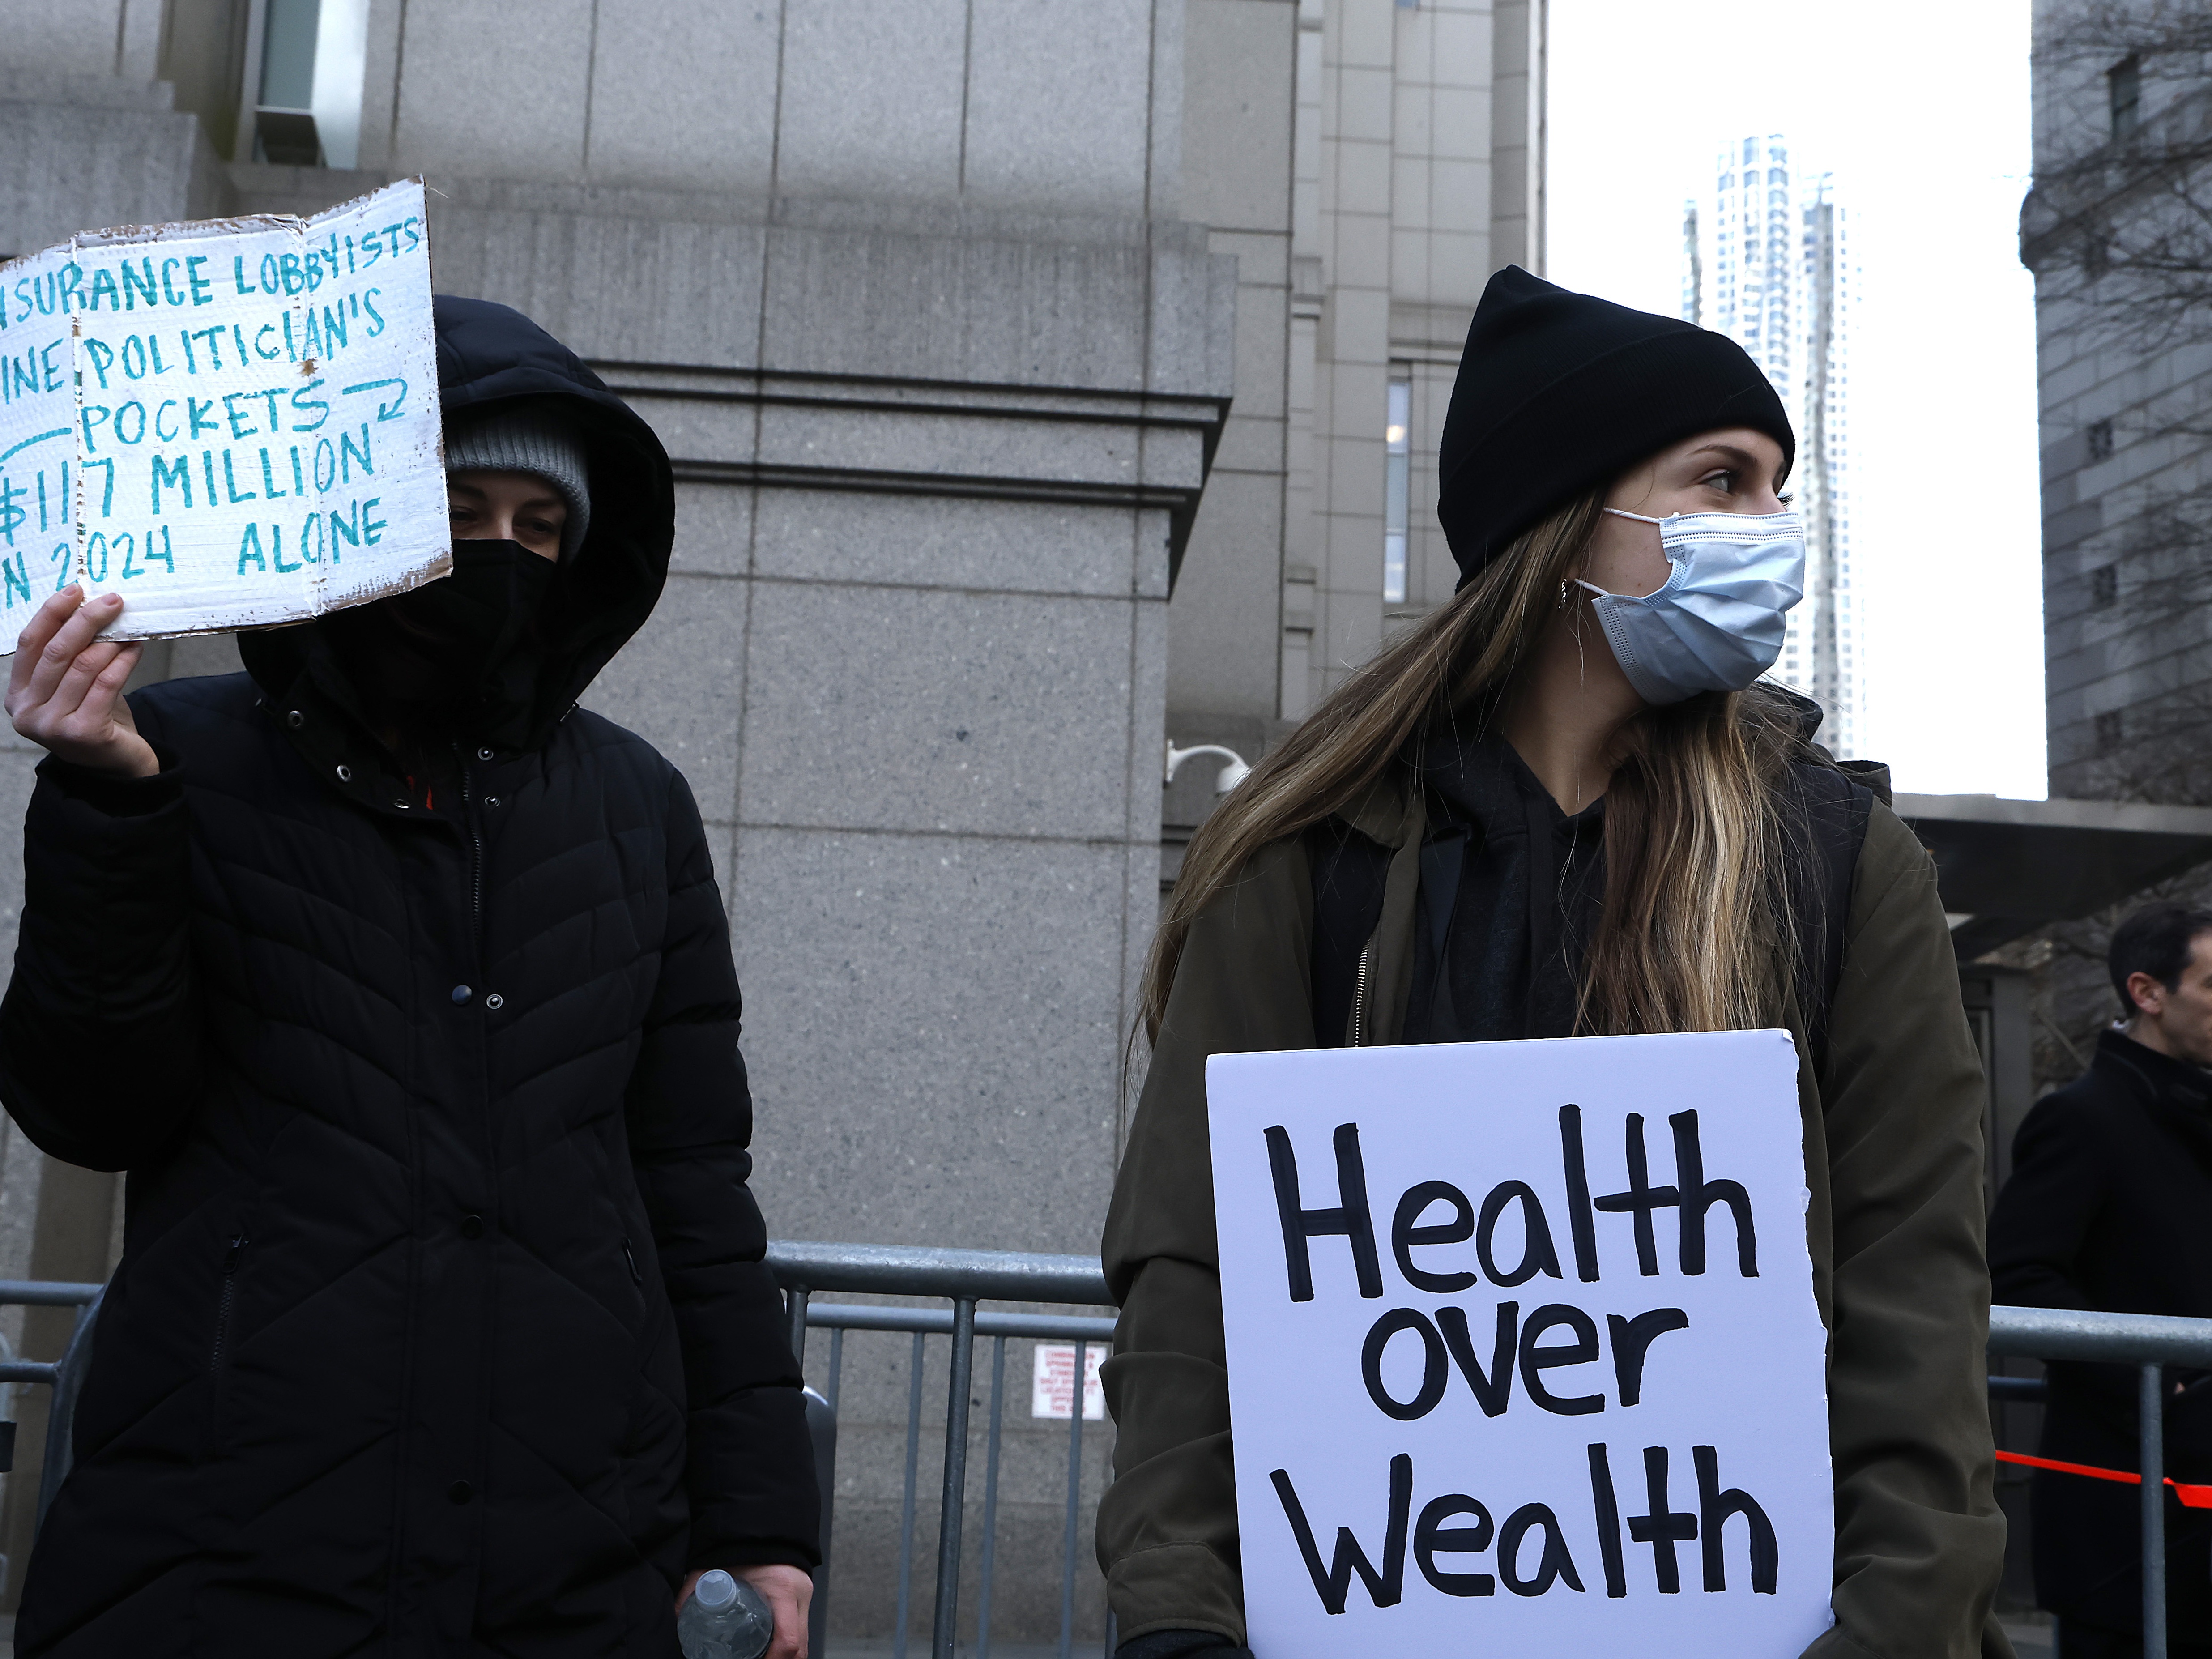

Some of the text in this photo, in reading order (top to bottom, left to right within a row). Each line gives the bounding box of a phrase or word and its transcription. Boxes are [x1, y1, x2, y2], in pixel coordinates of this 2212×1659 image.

[234, 215, 421, 297] LOBBYISTS
[82, 287, 385, 390] POLITICIAN'S
[81, 378, 330, 455] POCKETS
[150, 422, 375, 515] MILLION
[50, 525, 175, 592] 2024
[237, 496, 388, 576] ALONE
[1263, 1104, 1760, 1303] Health
[1361, 1301, 1689, 1421] over
[1269, 1442, 1778, 1615] Wealth
